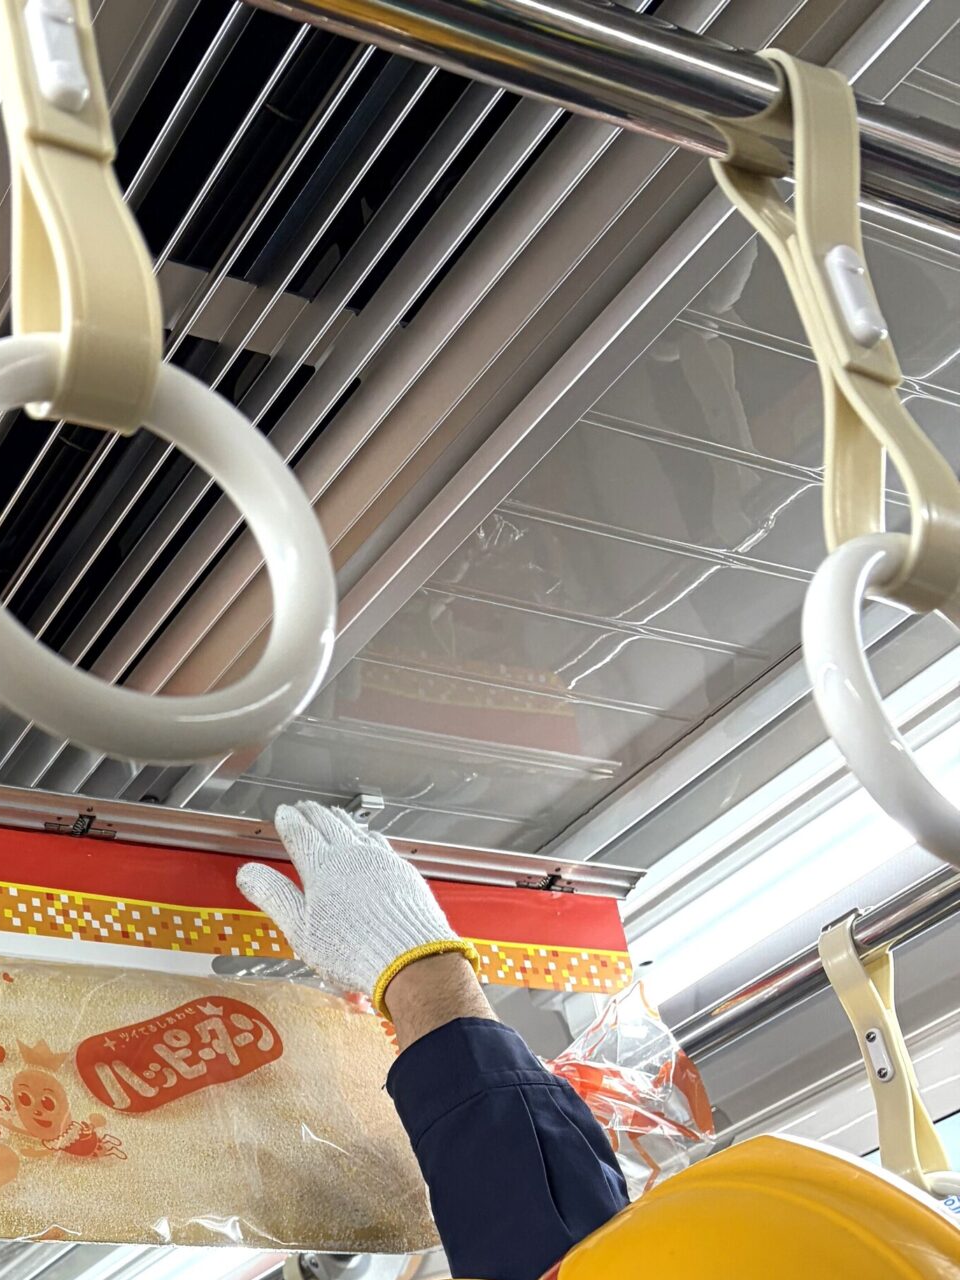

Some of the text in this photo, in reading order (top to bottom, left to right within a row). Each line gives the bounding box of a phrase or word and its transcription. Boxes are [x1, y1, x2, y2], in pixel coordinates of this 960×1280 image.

[119, 1007, 196, 1042] ツイてるしあわせ
